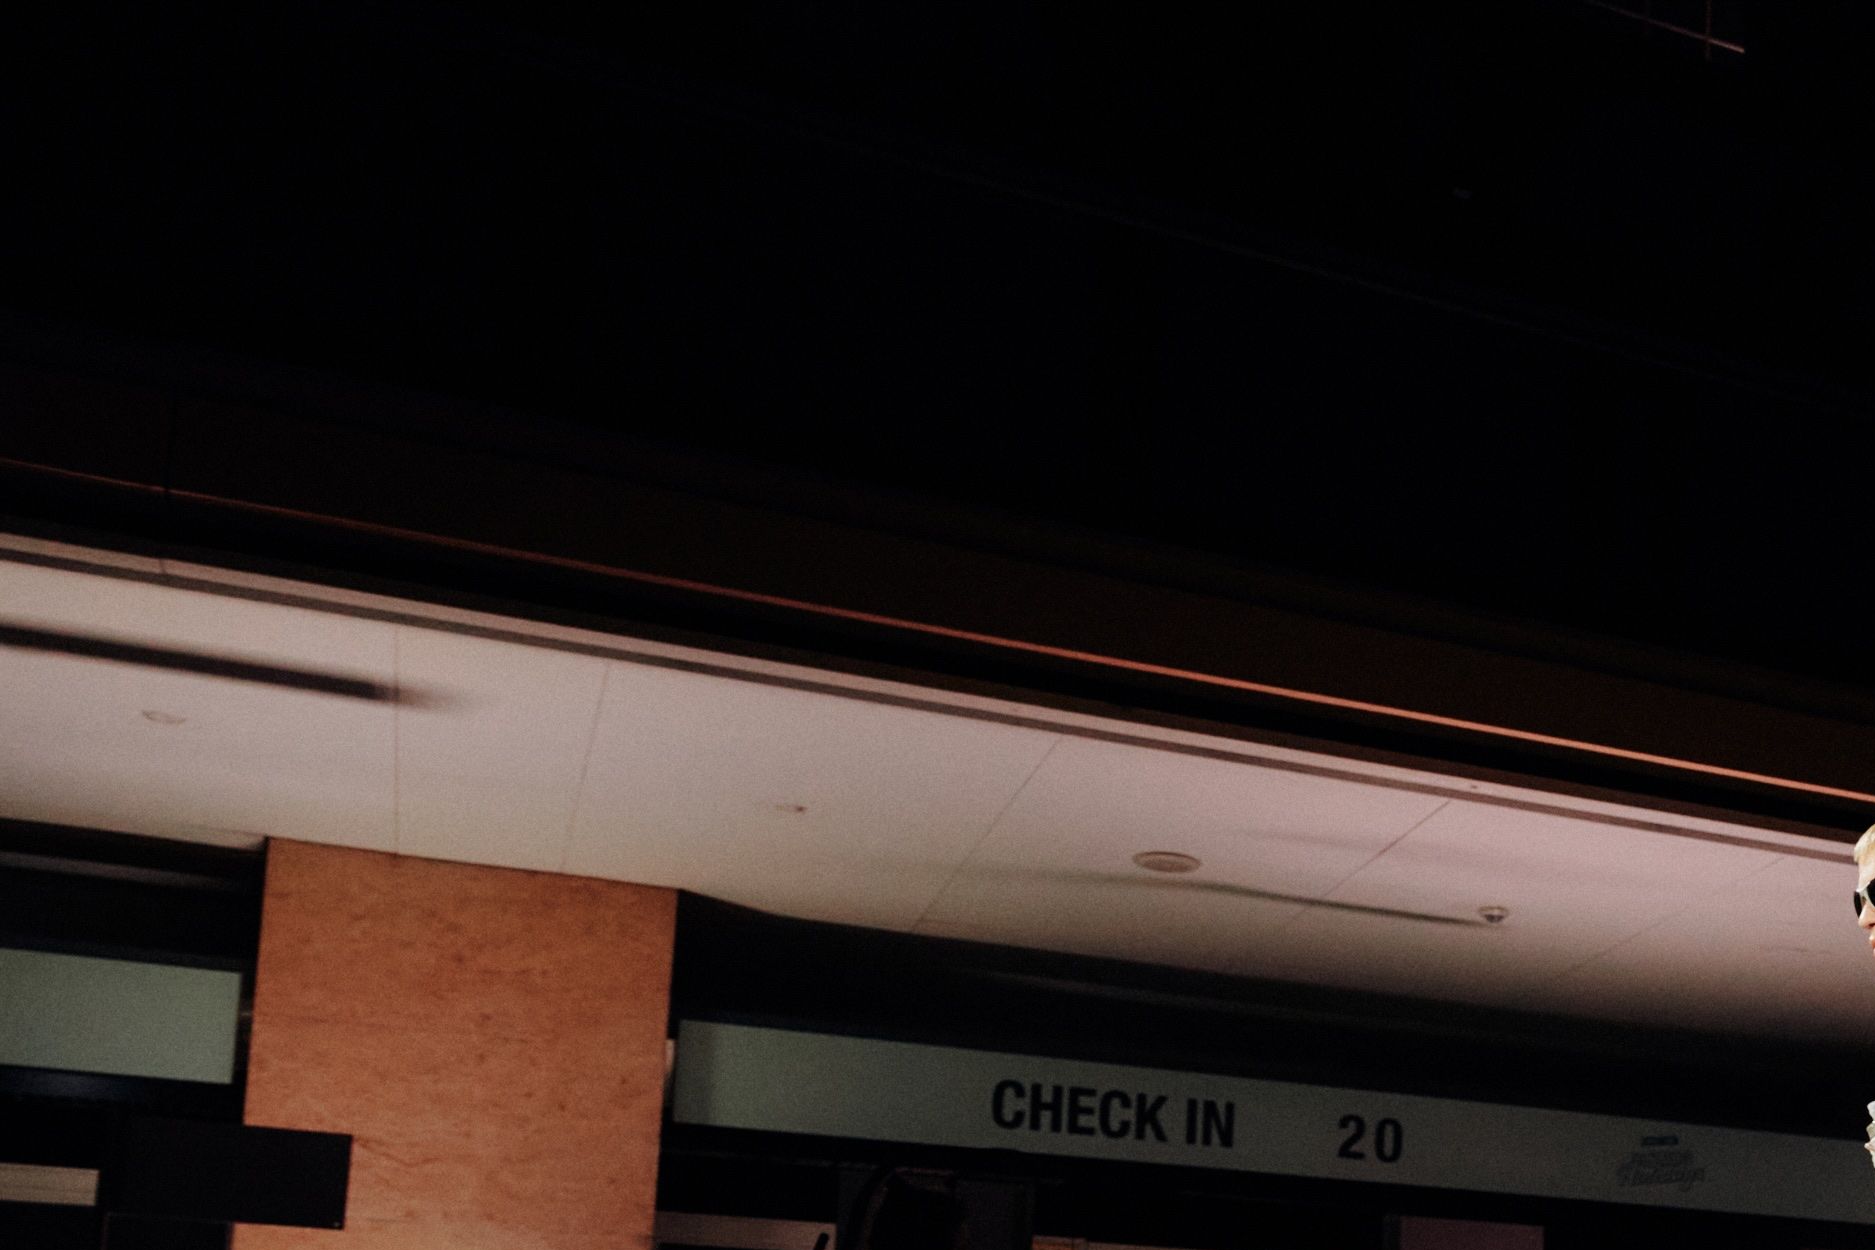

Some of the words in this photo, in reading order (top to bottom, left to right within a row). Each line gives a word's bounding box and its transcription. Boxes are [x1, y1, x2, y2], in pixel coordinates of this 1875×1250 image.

[991, 1079, 1169, 1144] CHECK
[1185, 1096, 1236, 1149] IN
[1336, 1113, 1404, 1164] 20
